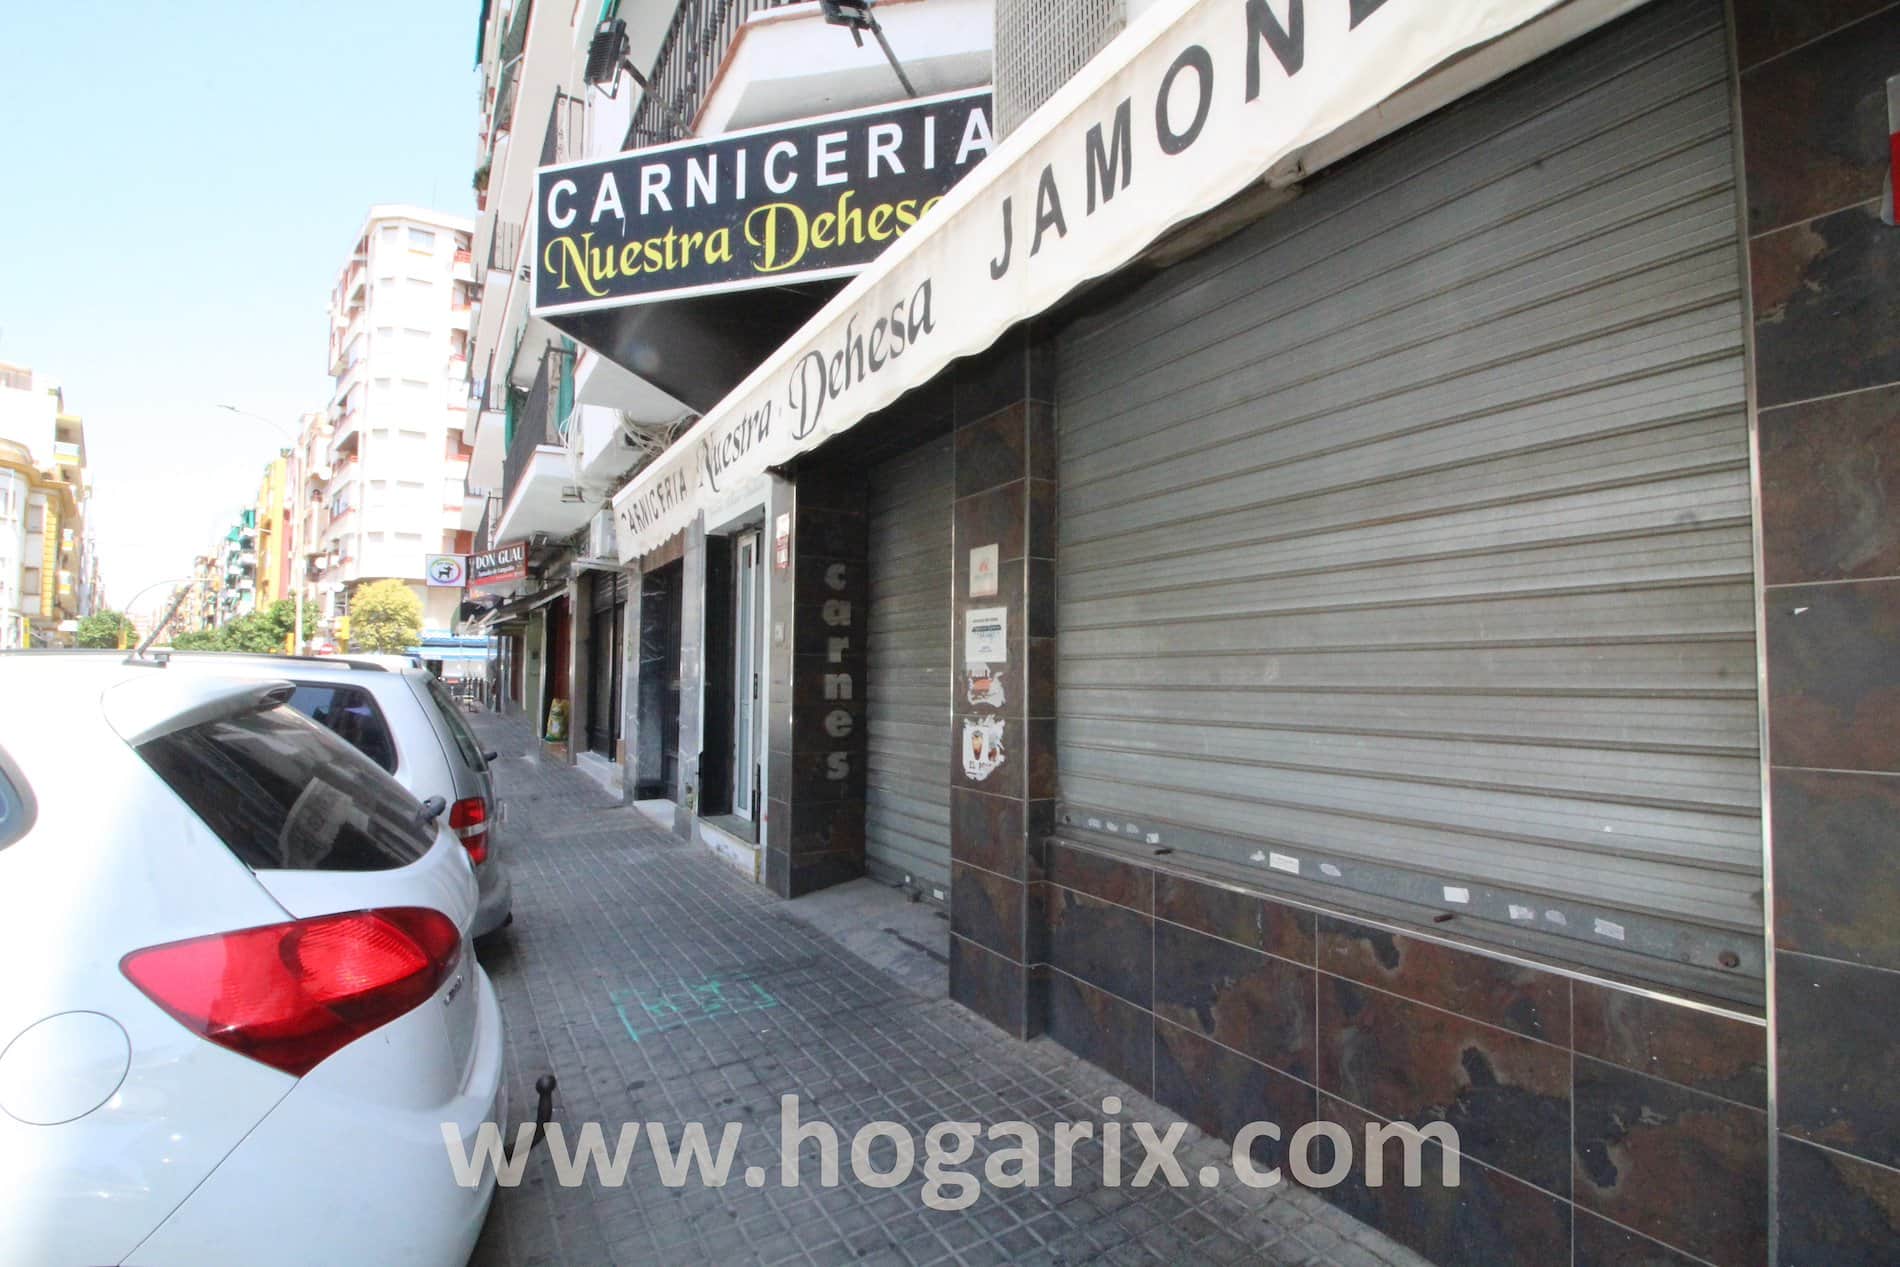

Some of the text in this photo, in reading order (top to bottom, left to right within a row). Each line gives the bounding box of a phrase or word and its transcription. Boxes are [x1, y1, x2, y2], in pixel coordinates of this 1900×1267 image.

[546, 107, 992, 229] CARNICERIA
[544, 224, 733, 297] Nuestra
[789, 277, 936, 441] Dehesa
[476, 552, 496, 570] DON
[822, 562, 854, 781] carnes
